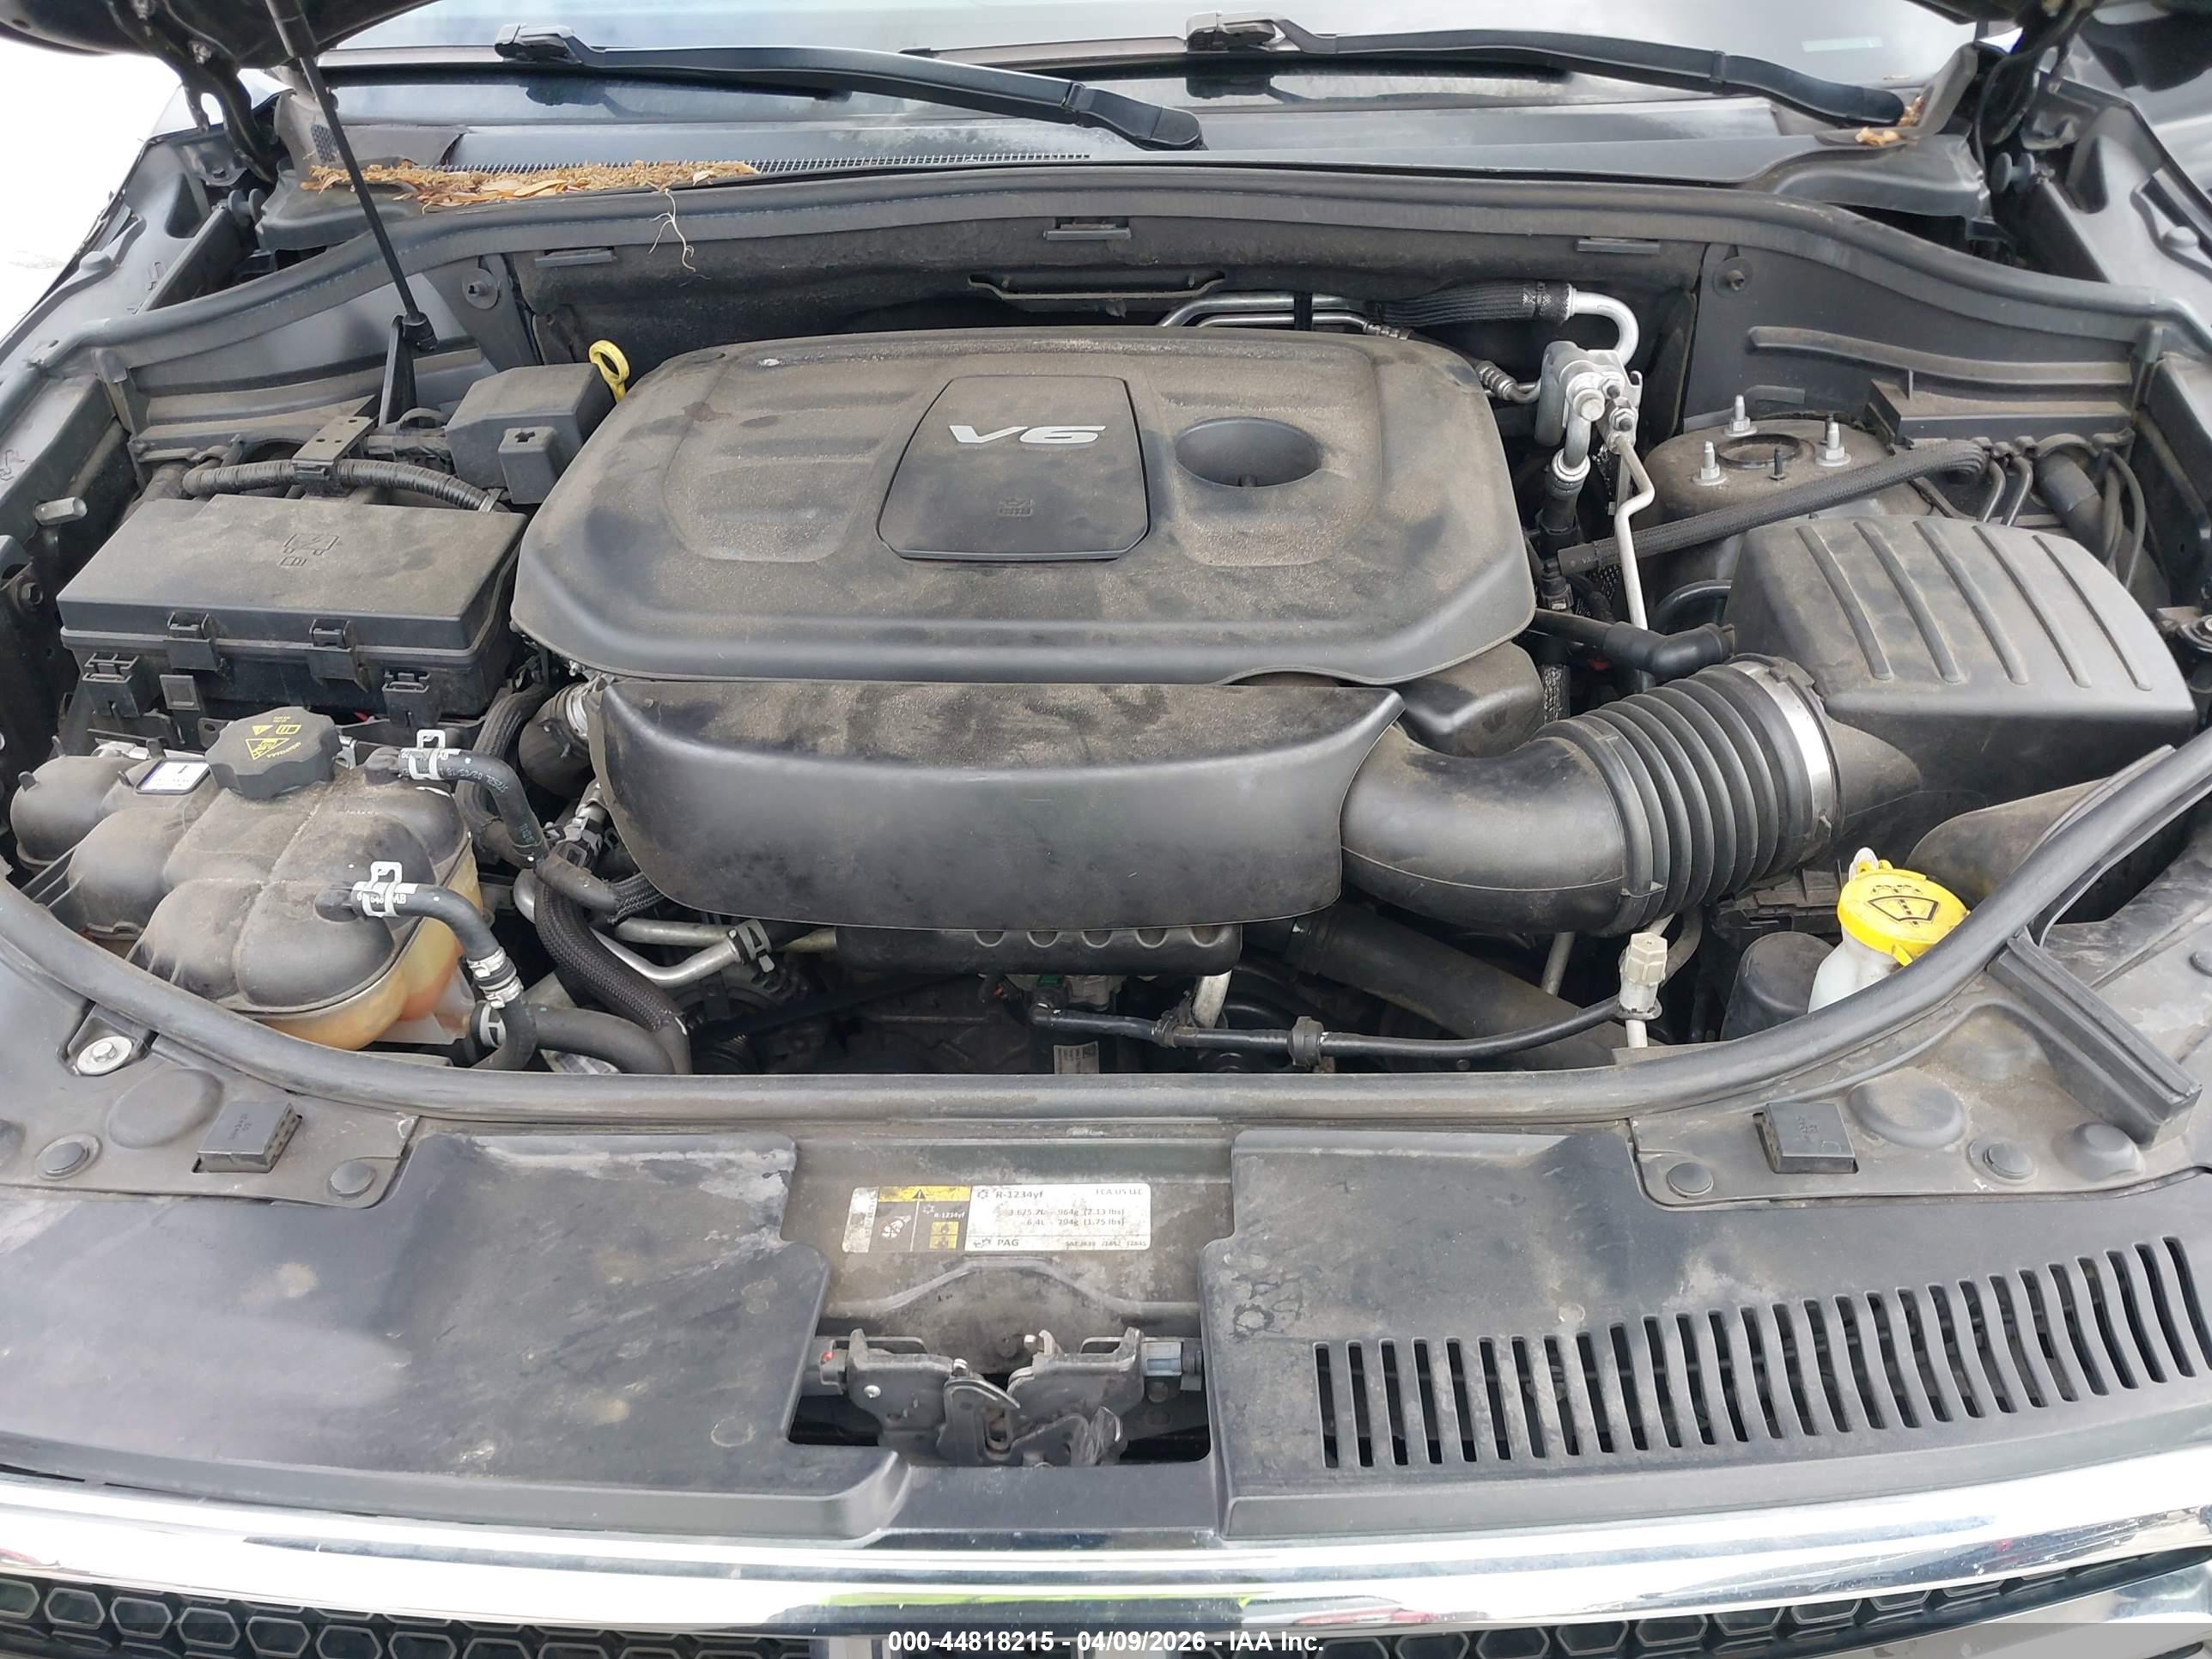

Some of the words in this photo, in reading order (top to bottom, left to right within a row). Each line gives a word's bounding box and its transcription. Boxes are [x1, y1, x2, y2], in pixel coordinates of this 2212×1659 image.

[949, 425, 1107, 443] V6
[995, 1190, 1044, 1200] R-1234yf
[1057, 1208, 1079, 1217] 964g
[1057, 1218, 1079, 1227] 794g
[997, 1238, 1019, 1247] PAG
